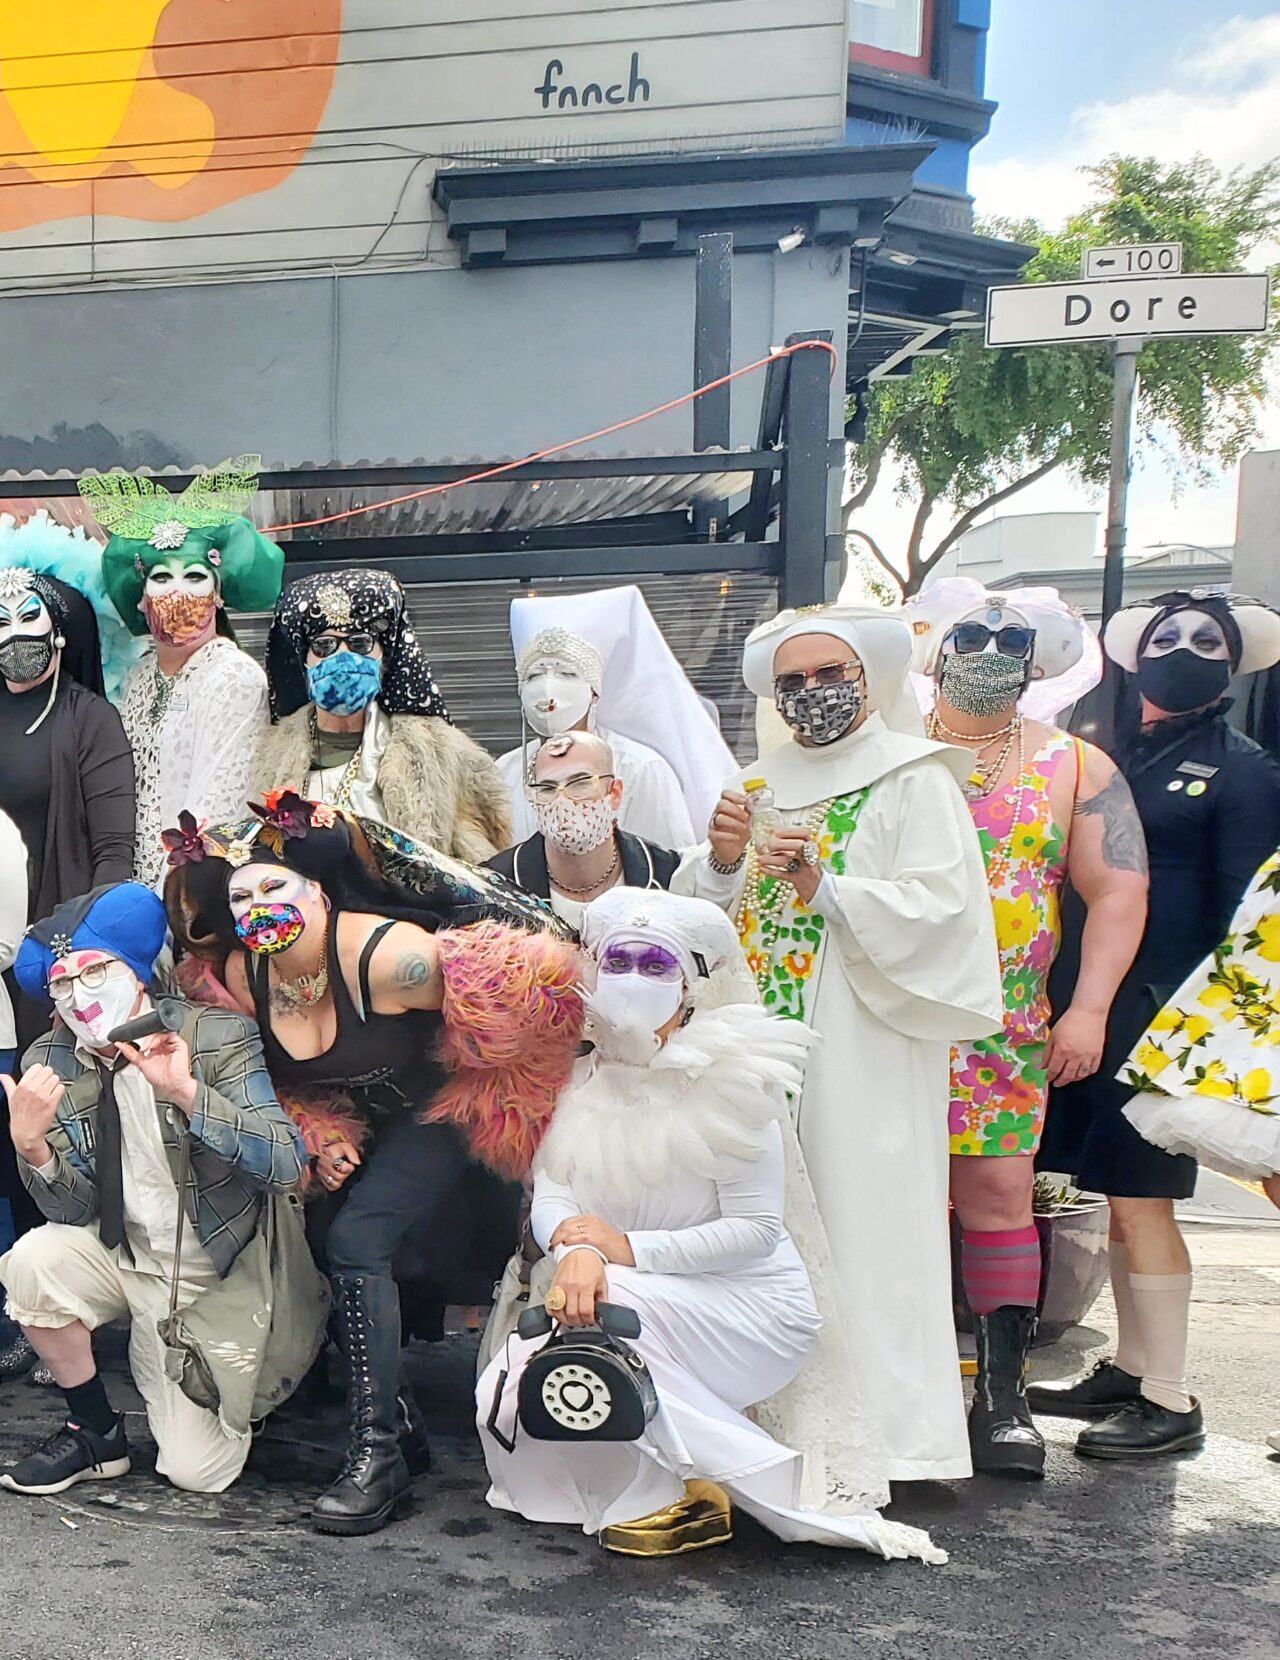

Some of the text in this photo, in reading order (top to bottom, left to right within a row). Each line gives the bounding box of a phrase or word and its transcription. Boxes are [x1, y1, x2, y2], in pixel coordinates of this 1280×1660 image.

[534, 52, 650, 108] fnnch
[1126, 249, 1173, 272] 100
[1064, 294, 1198, 326] Dore
